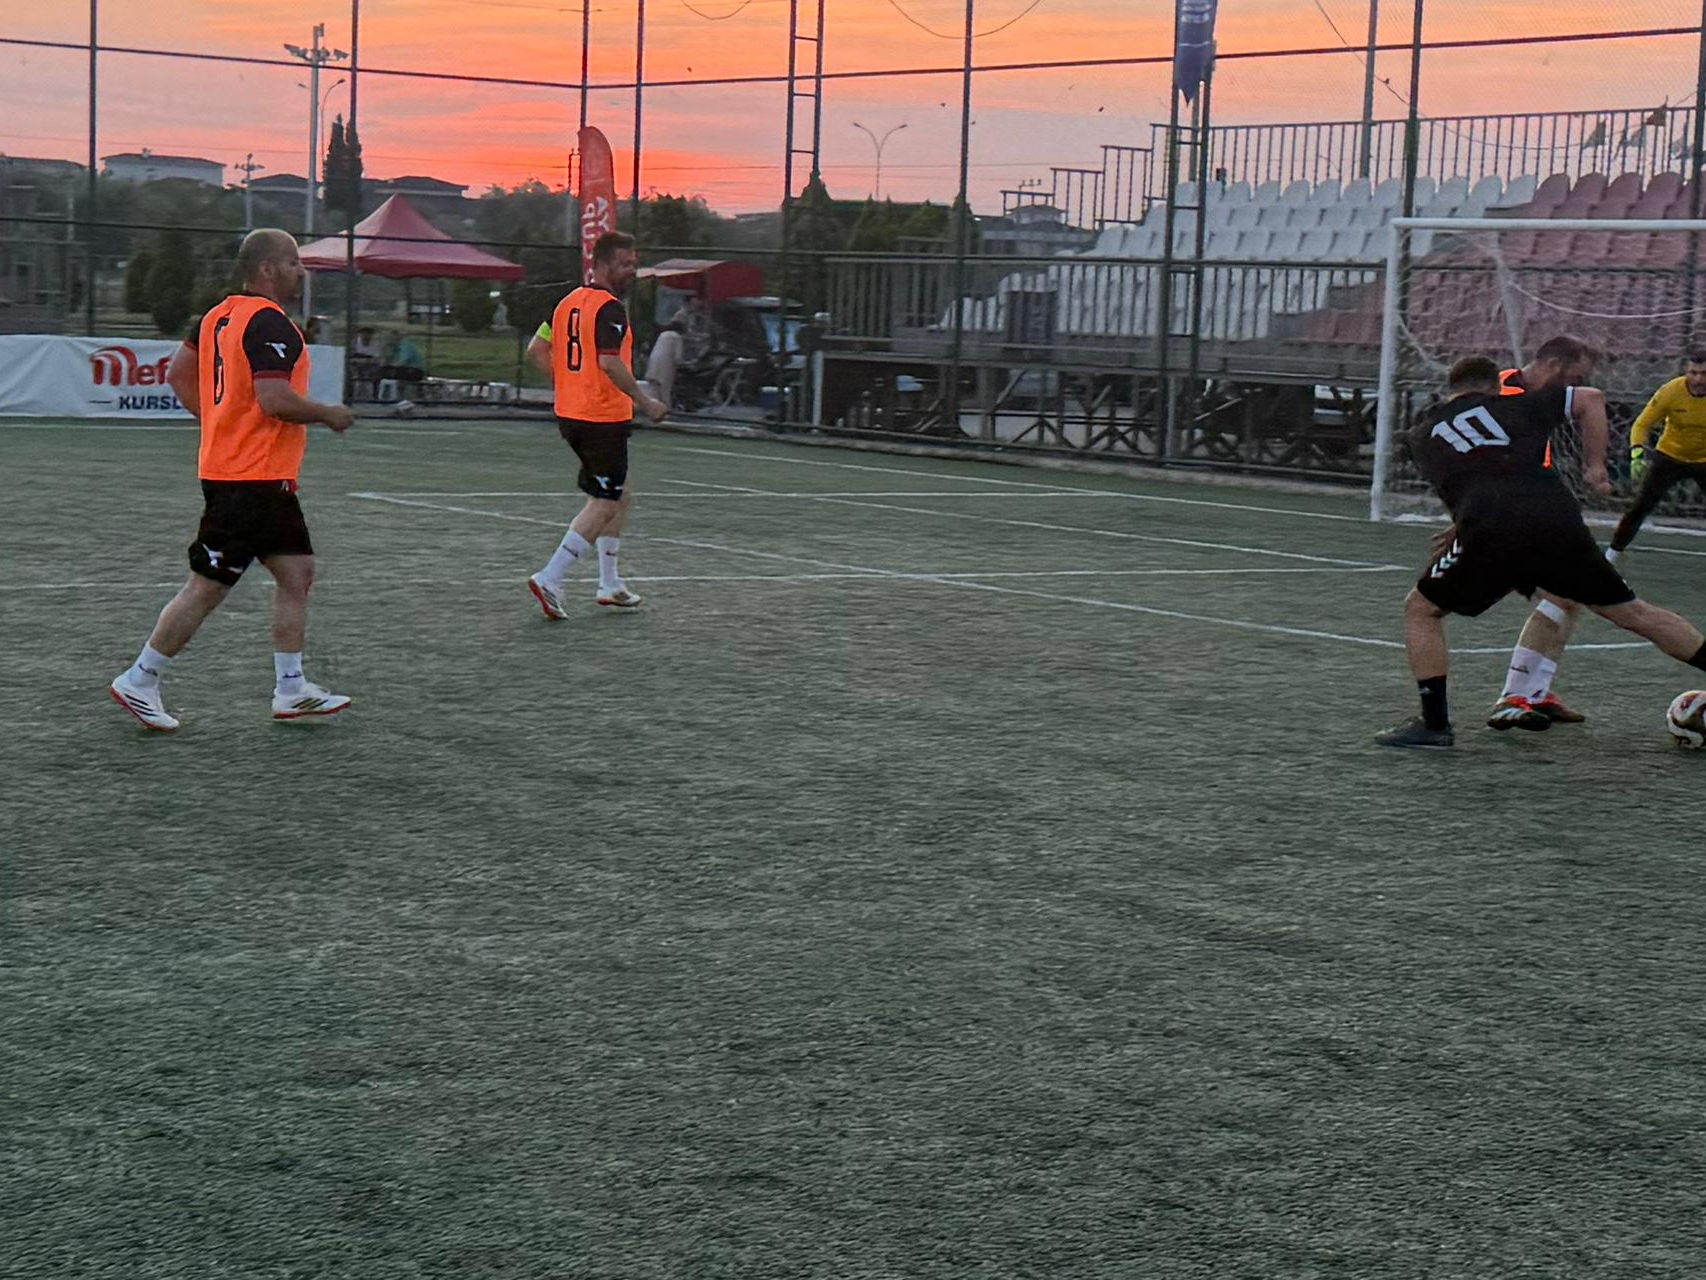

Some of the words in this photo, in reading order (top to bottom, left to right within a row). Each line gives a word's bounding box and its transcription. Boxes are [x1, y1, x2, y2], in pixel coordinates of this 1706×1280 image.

[567, 307, 583, 372] 8
[118, 394, 183, 410] KURSL
[1430, 405, 1511, 454] 10
